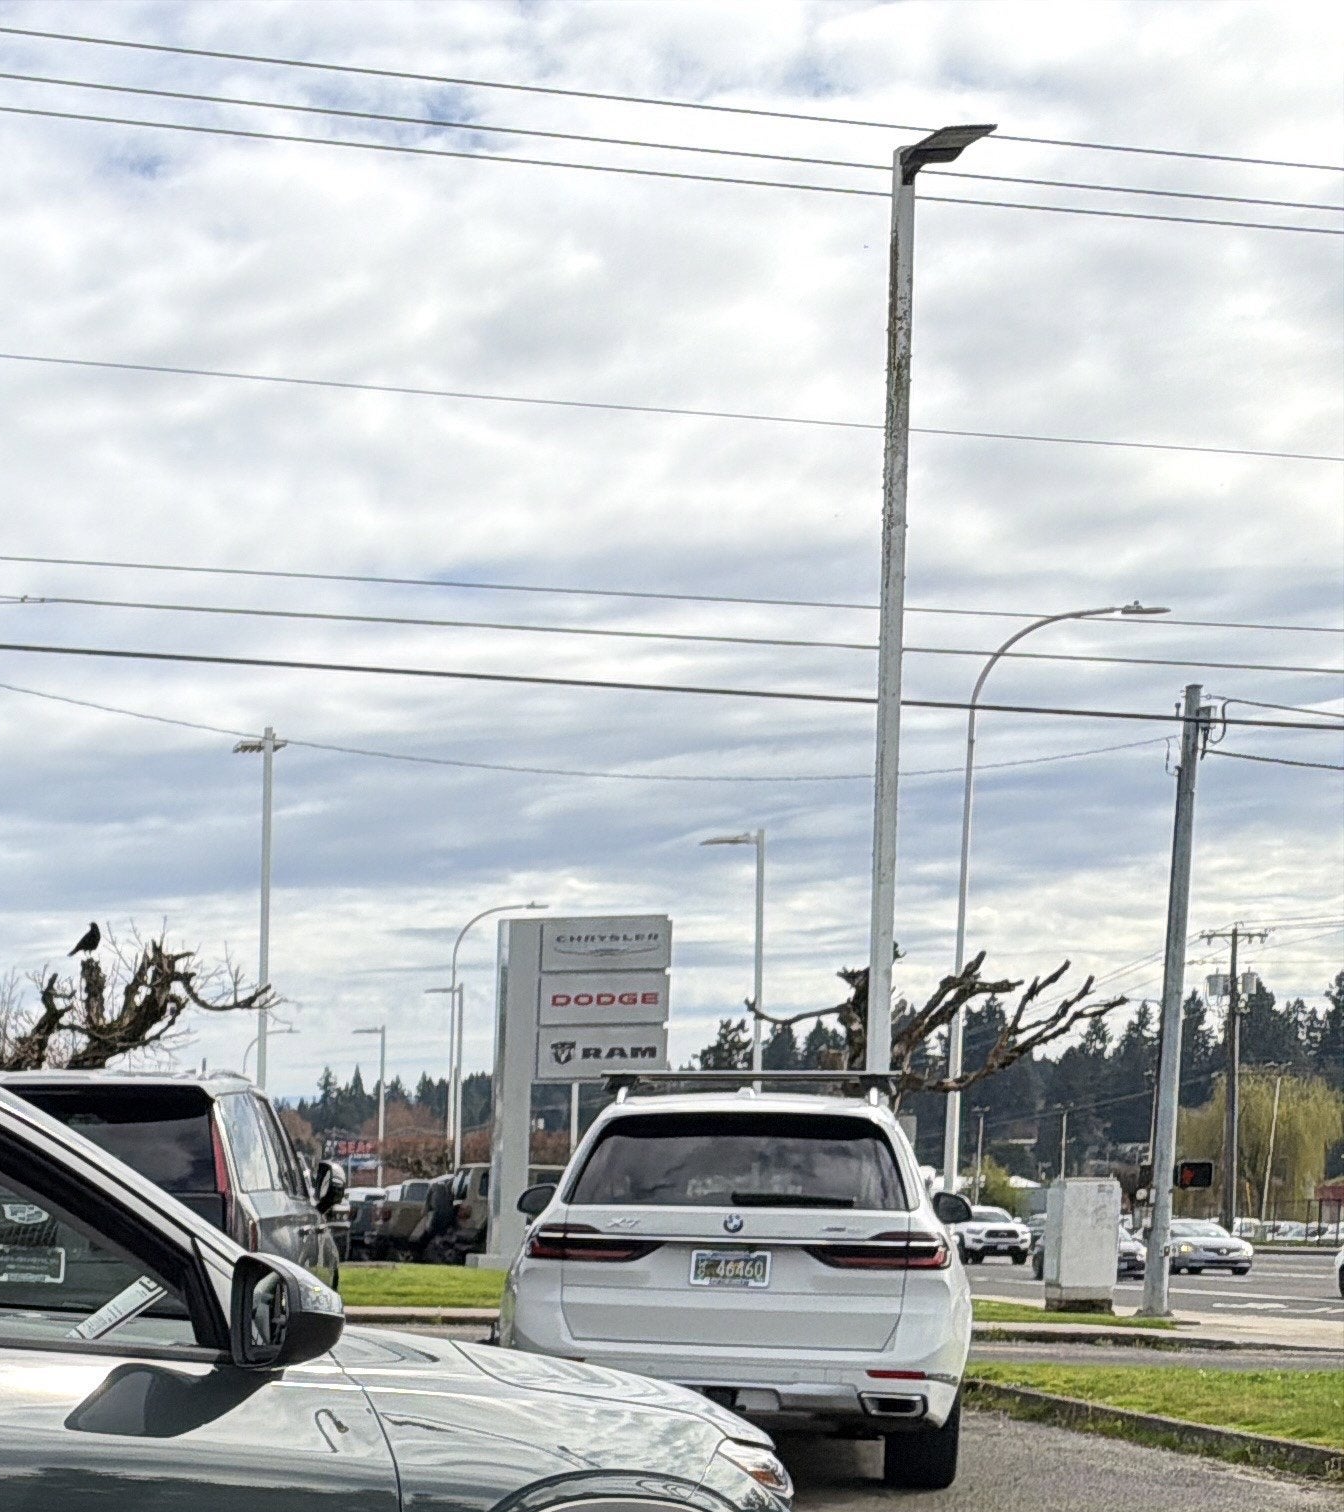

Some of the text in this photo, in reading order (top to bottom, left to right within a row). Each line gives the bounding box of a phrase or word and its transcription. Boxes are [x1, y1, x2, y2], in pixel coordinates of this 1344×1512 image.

[556, 933, 659, 943] CHRYSLER
[551, 992, 659, 1007] DODGE
[581, 1046, 657, 1059] RAM
